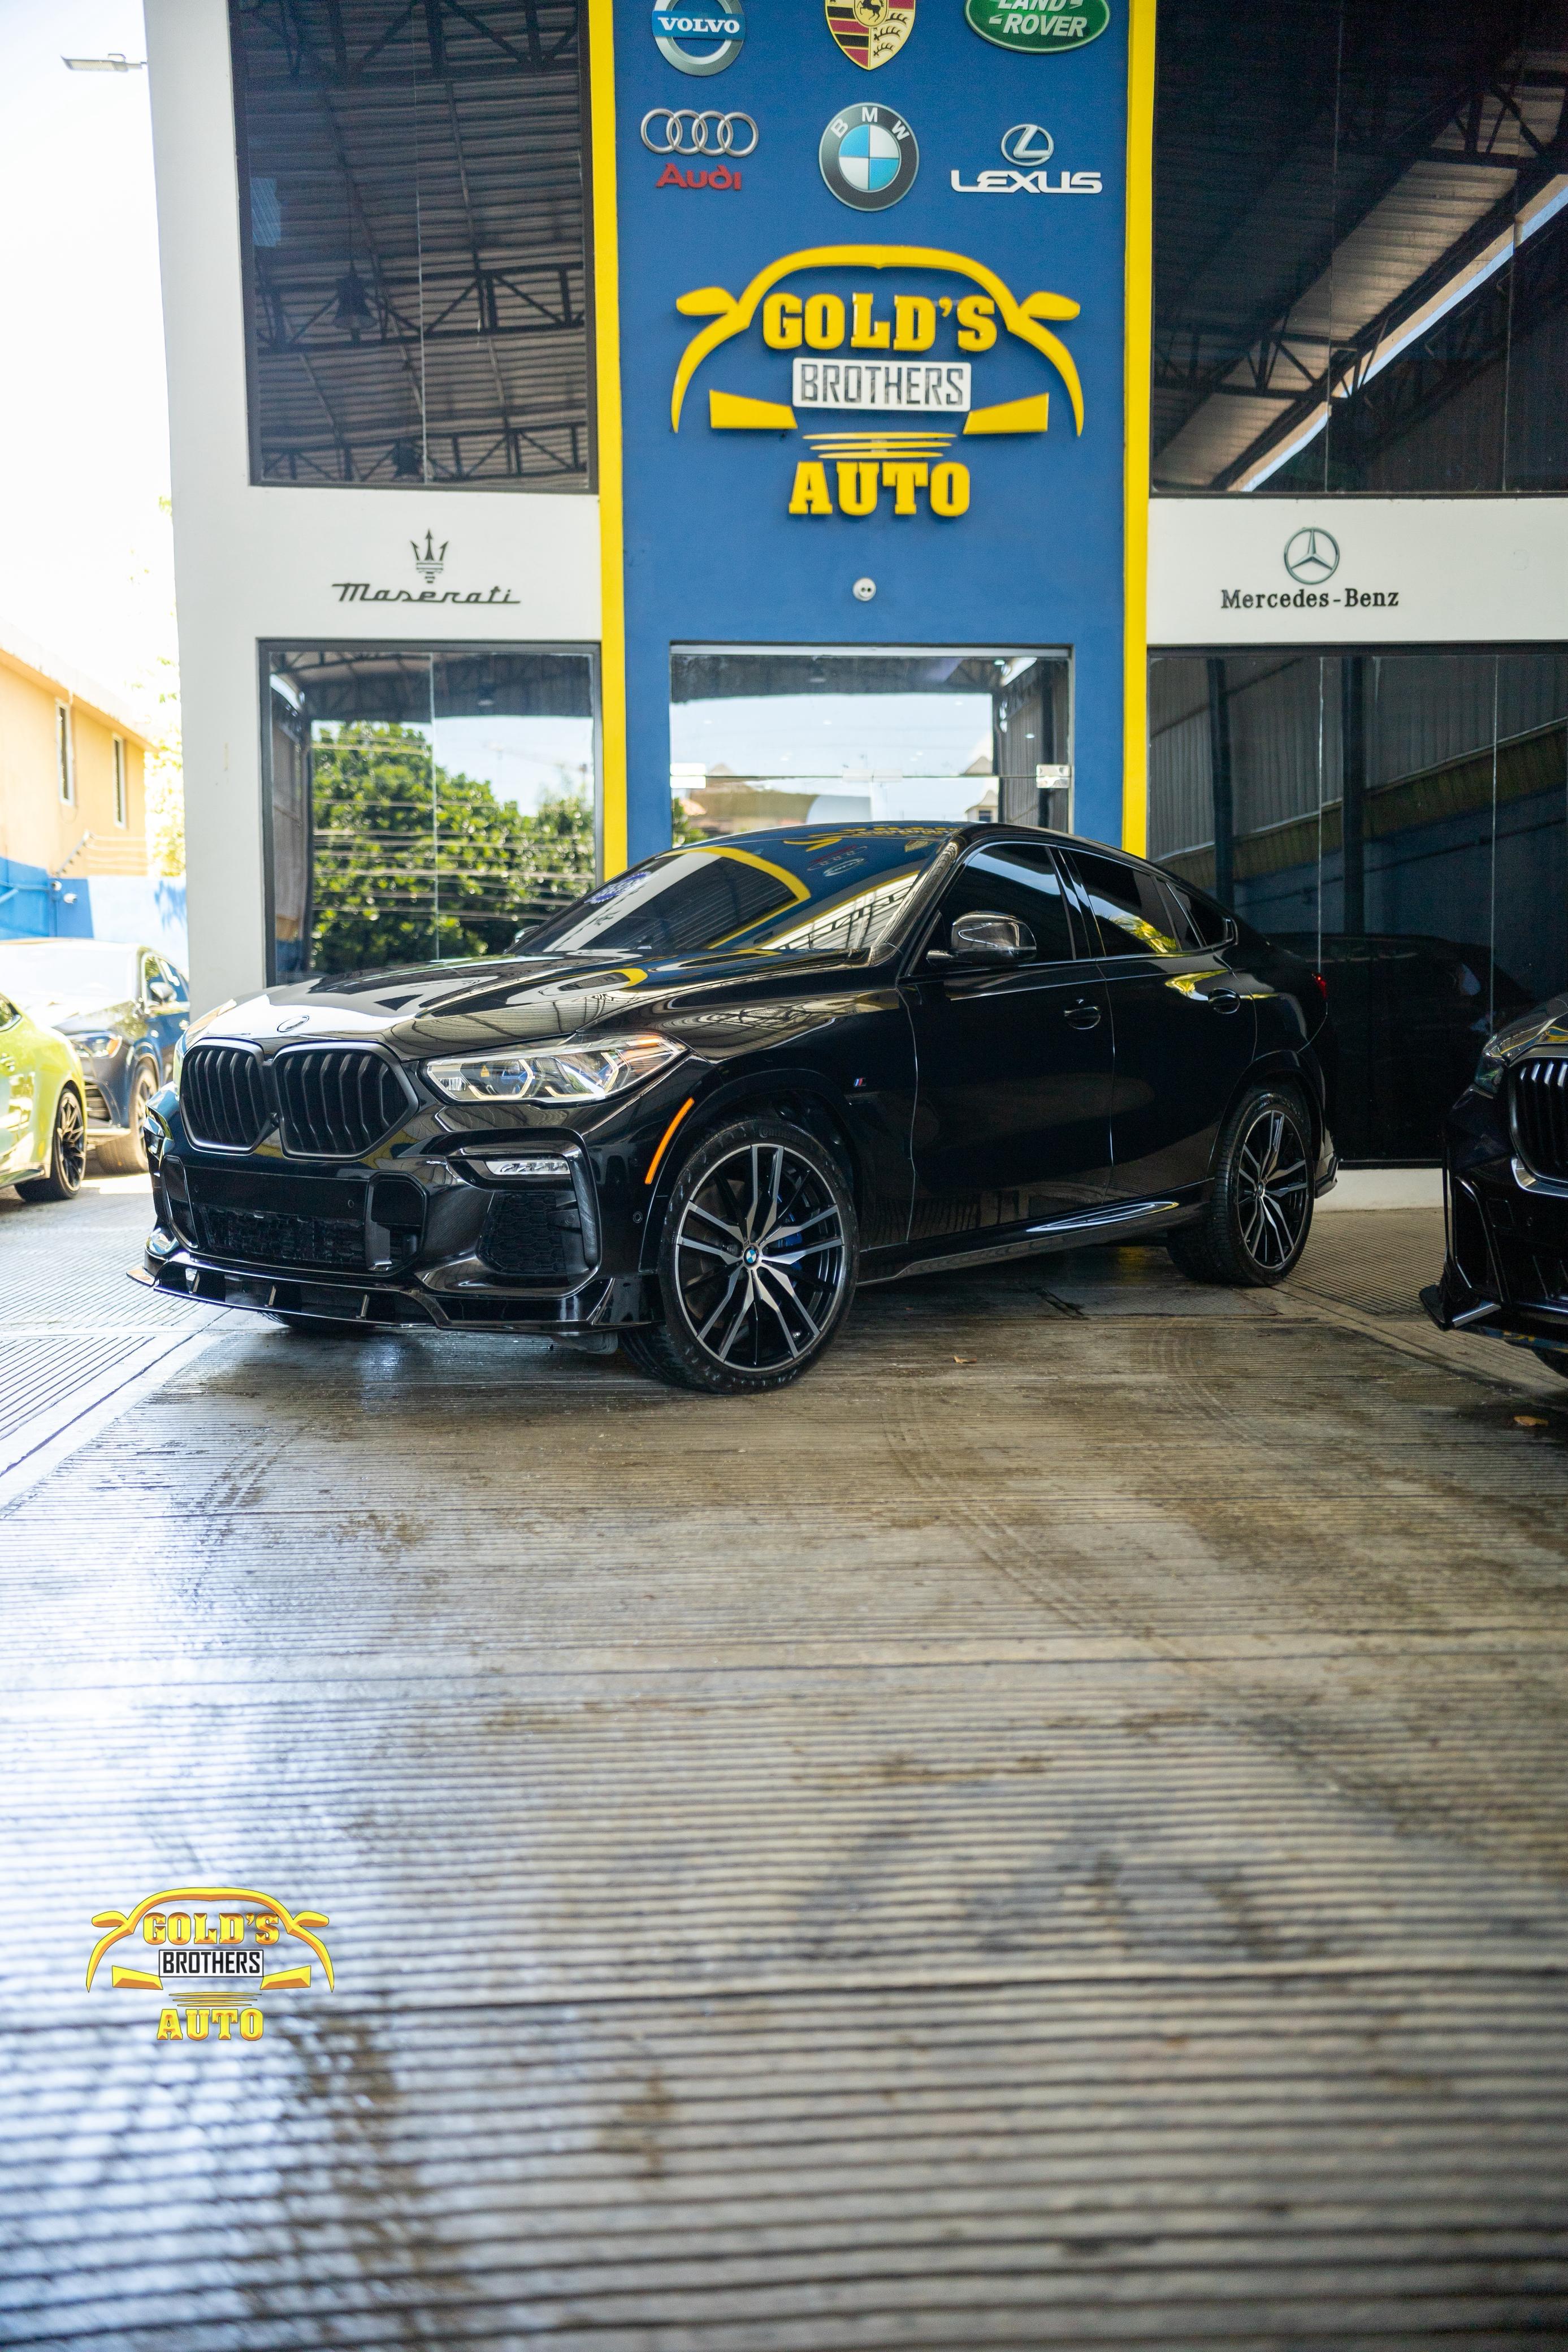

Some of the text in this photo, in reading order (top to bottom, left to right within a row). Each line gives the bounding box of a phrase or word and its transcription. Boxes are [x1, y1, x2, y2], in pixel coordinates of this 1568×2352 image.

[658, 17, 740, 33] VOLVO
[1003, 13, 1088, 37] ROVER
[830, 106, 910, 141] BMW
[655, 162, 742, 191] Audi
[951, 170, 1103, 194] LEXUS
[763, 293, 997, 352] GOLD'S
[800, 364, 964, 407] BROTHERS
[789, 461, 970, 517] AUTO
[332, 582, 521, 604] Maserati
[1221, 588, 1399, 608] Mercedes-Benz
